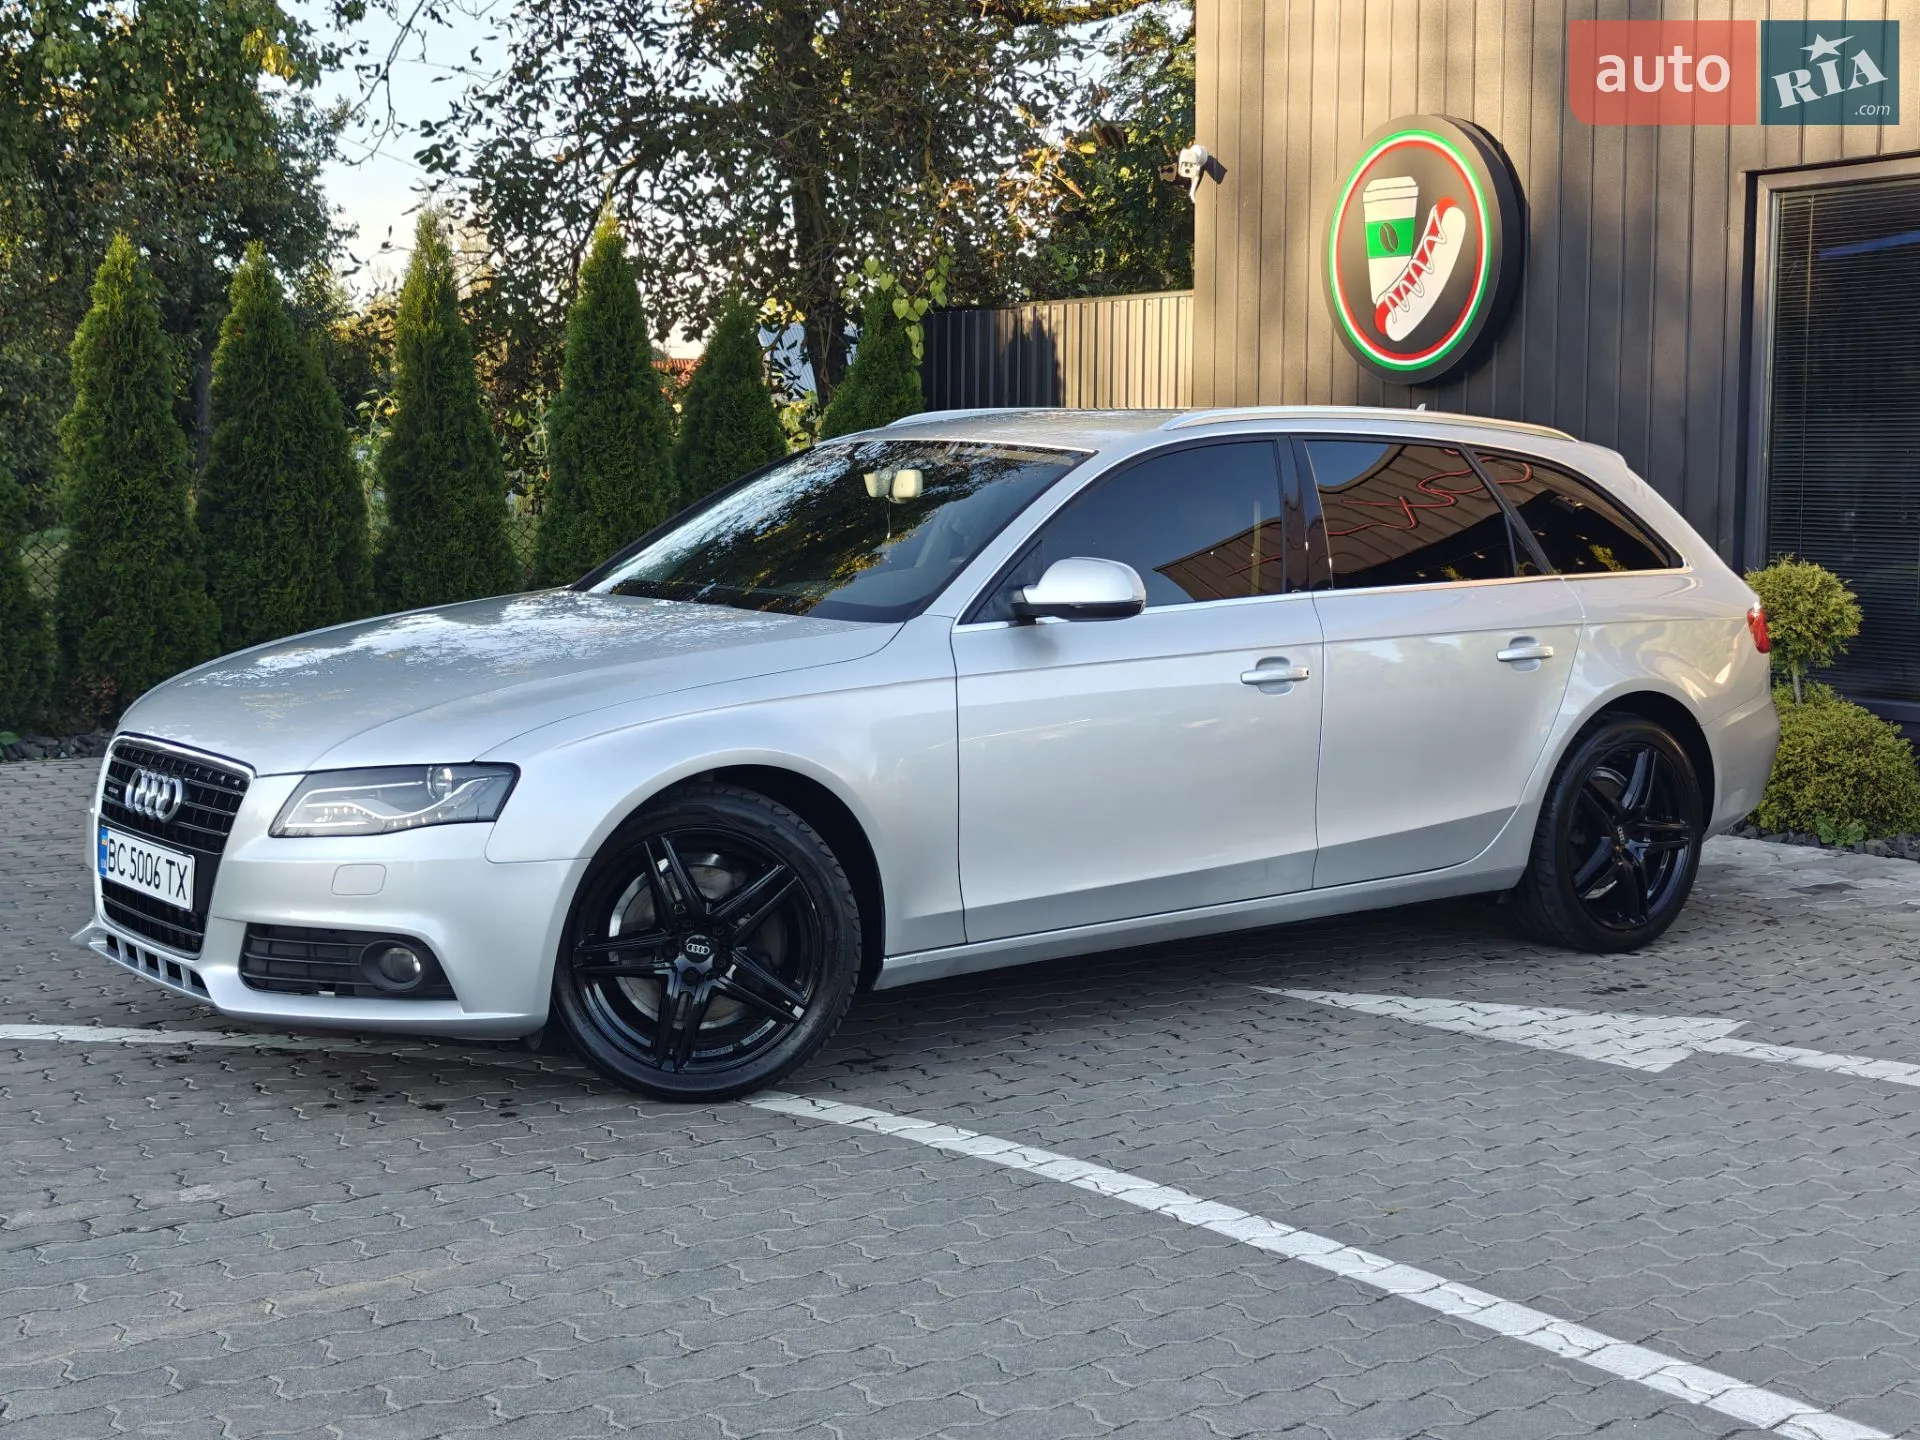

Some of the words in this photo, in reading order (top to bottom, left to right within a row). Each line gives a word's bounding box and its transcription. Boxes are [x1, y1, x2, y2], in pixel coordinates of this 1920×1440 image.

[108, 838, 127, 877] BC
[129, 846, 161, 890] 5006
[165, 859, 188, 901] TX
